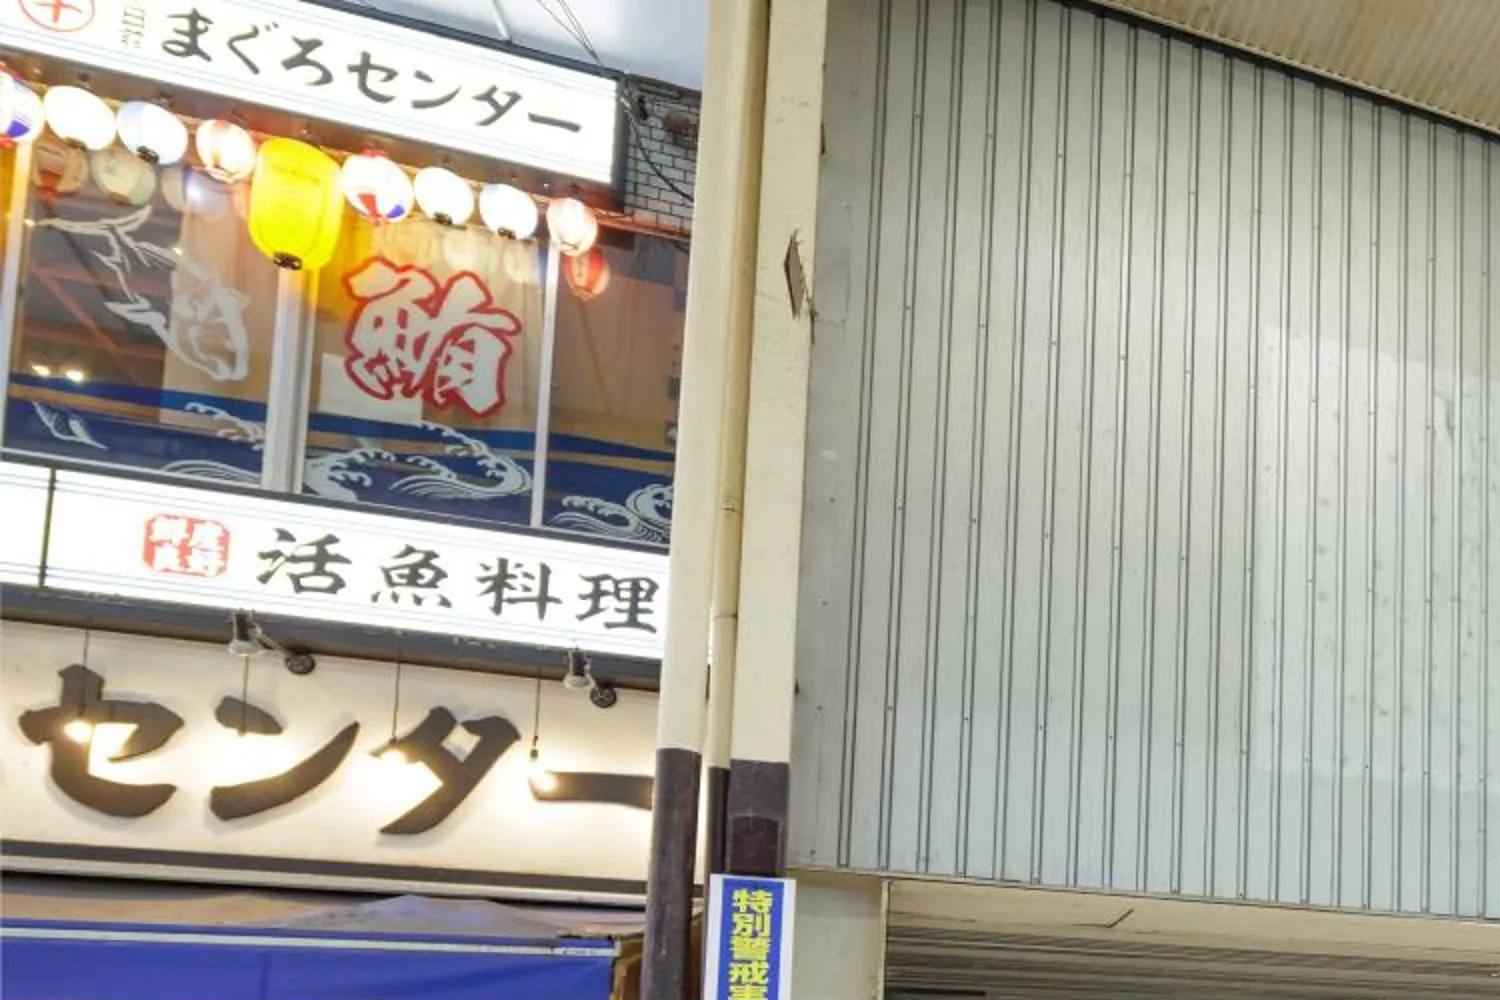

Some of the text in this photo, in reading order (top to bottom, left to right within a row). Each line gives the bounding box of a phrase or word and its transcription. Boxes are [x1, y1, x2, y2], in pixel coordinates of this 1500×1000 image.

[160, 7, 582, 134] まぐろセンター
[342, 255, 523, 418] 鮪
[257, 528, 660, 634] 活魚料理
[18, 664, 653, 836] センター
